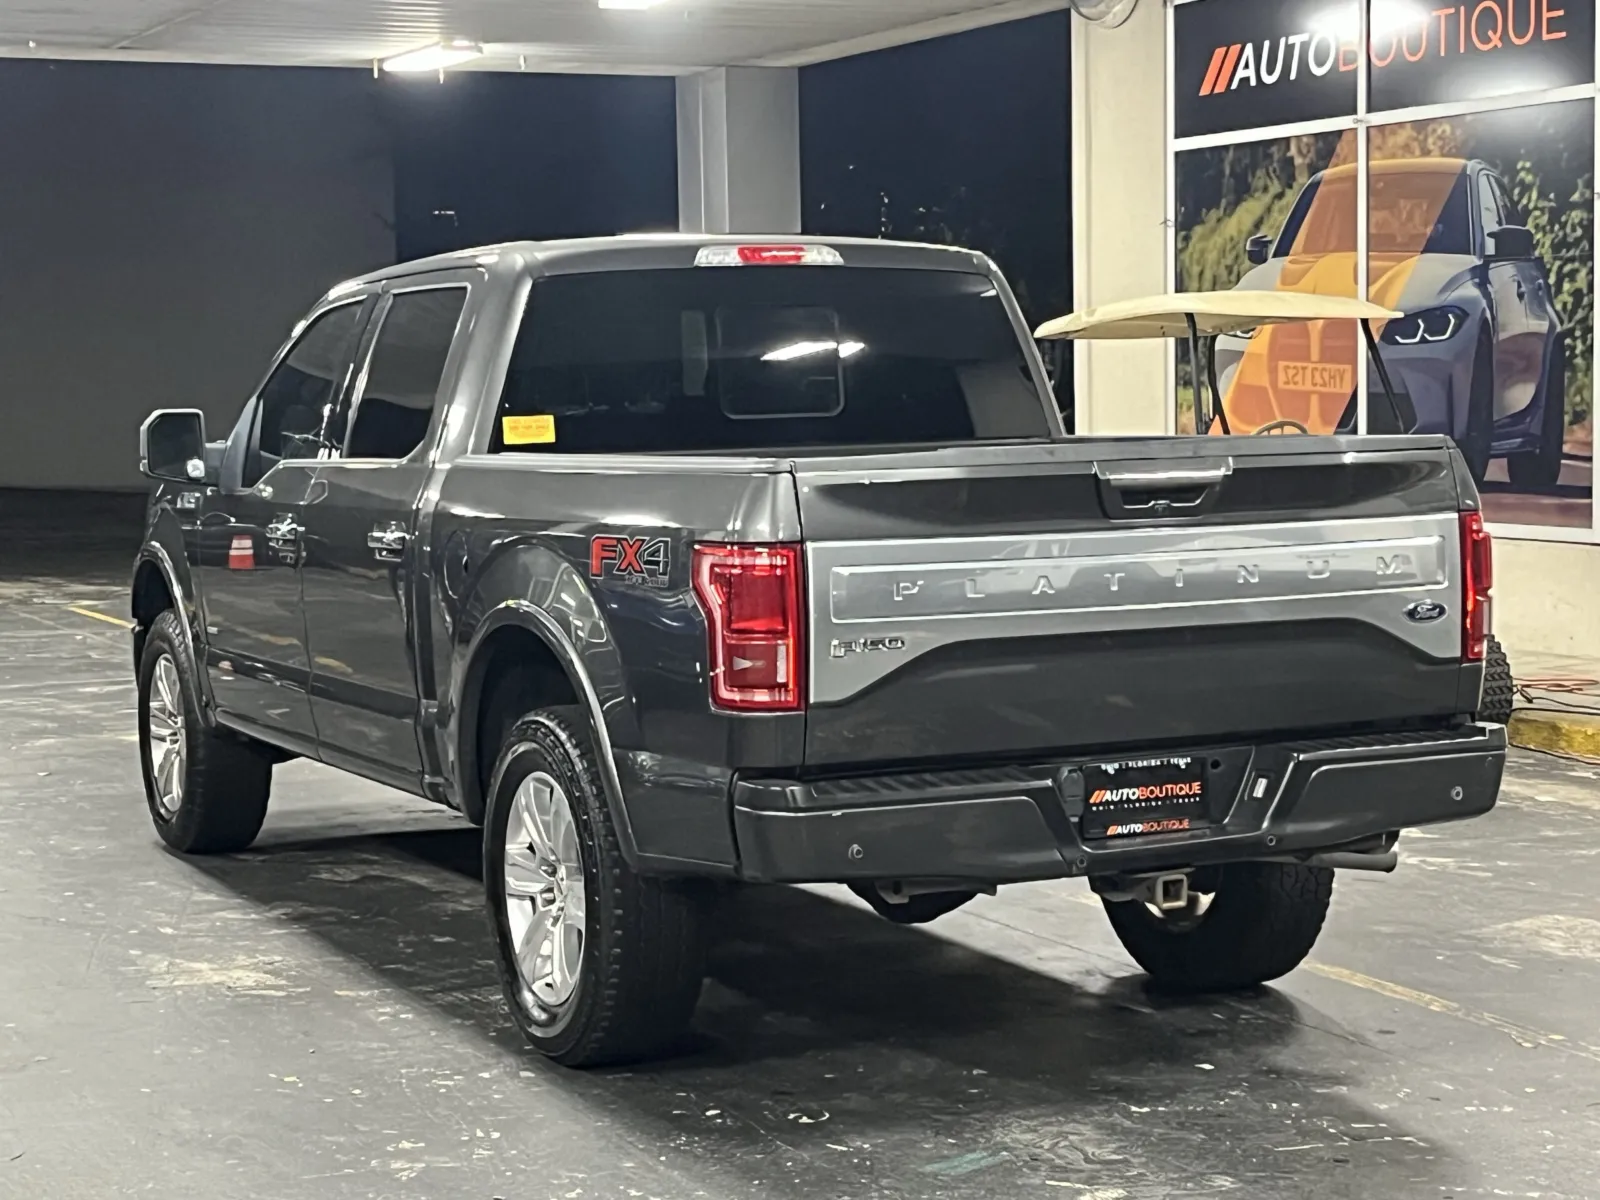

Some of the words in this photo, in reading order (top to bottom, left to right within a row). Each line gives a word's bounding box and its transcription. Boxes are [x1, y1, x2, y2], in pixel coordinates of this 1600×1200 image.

[590, 534, 671, 580] FX4
[893, 554, 1402, 601] PLATINUM
[1102, 782, 1201, 802] AUTOBOUTIQUE
[1114, 819, 1190, 834] AUTOBOUTIQUE
